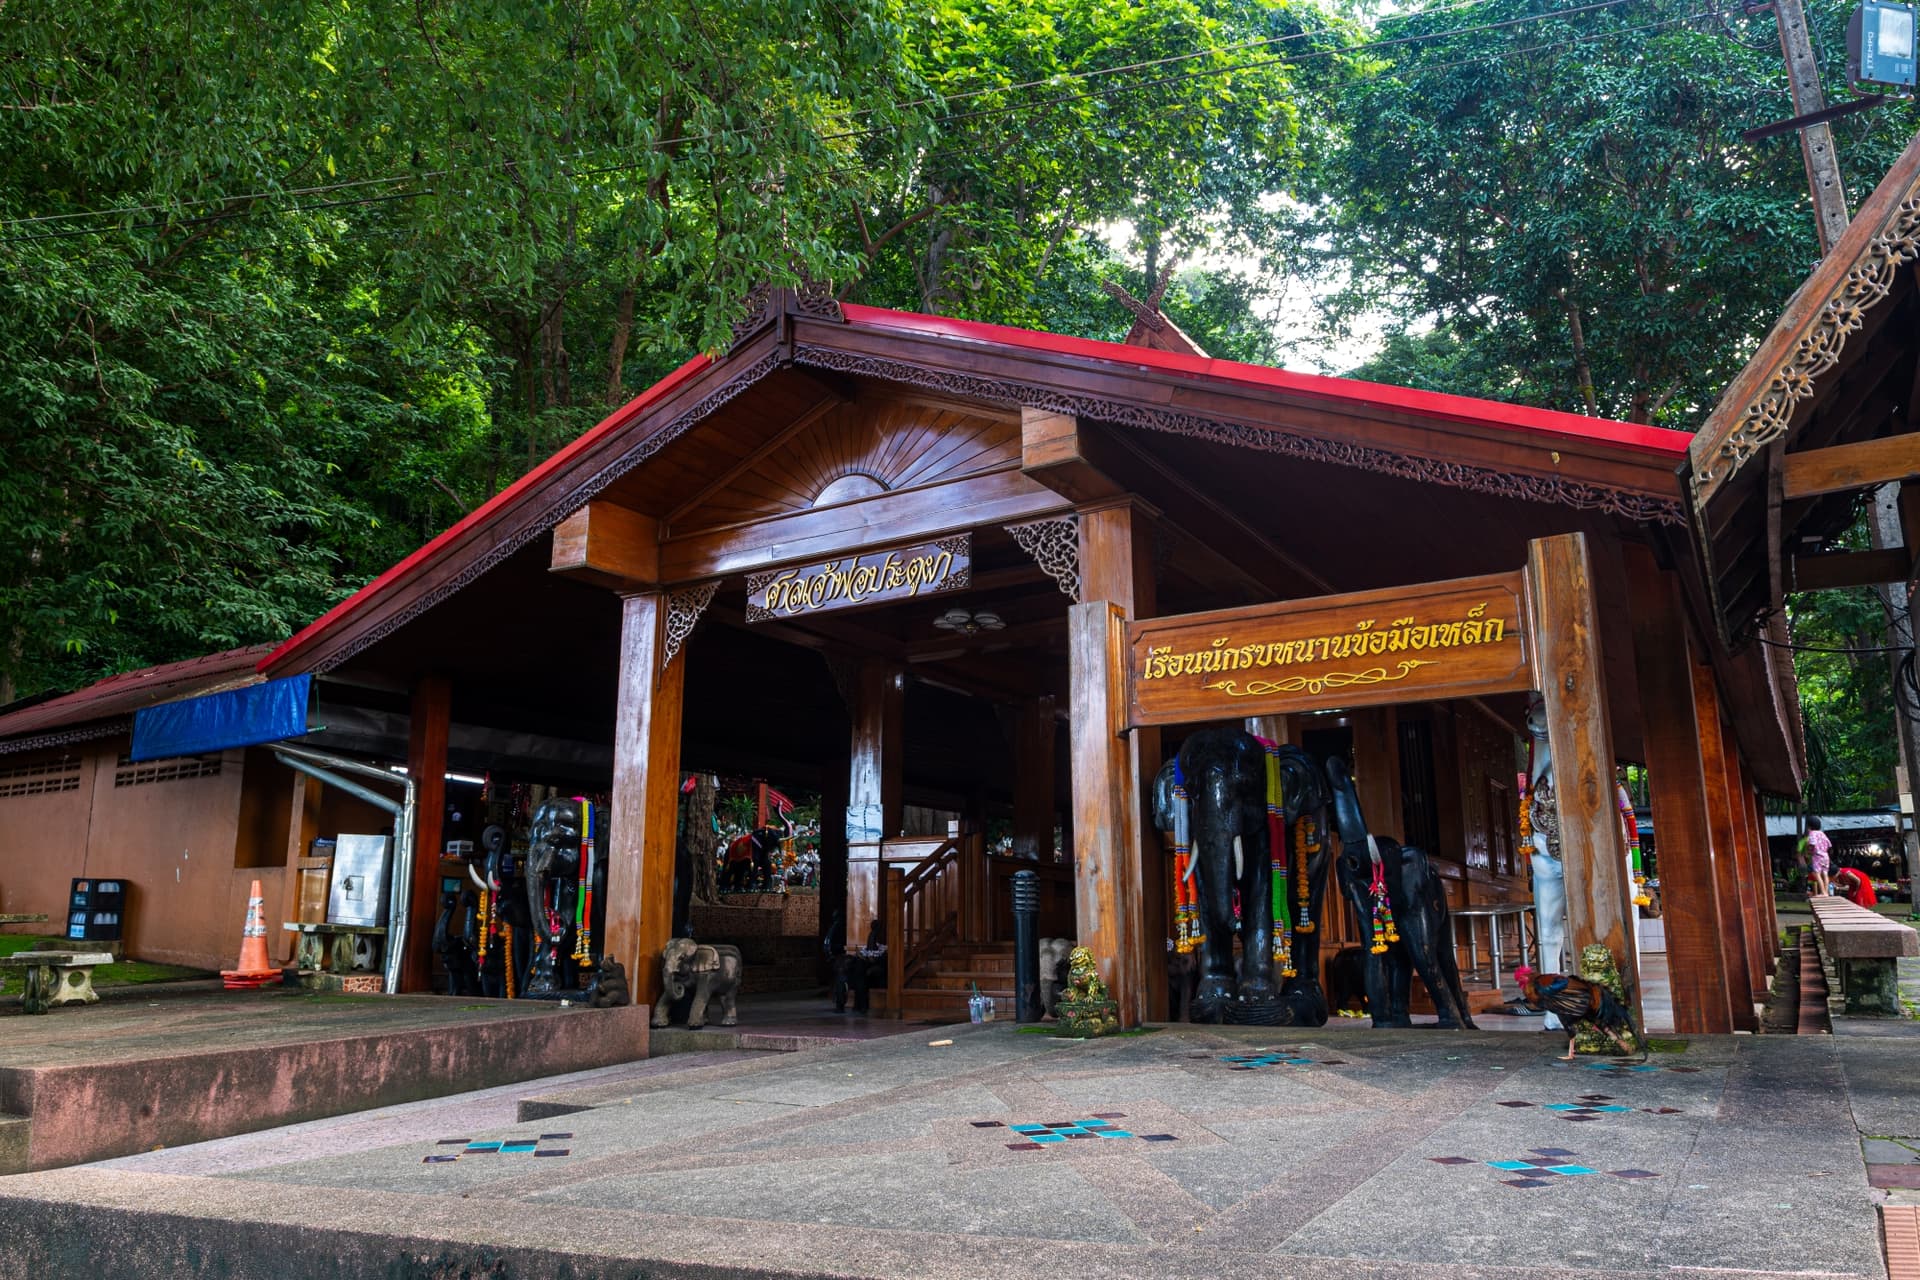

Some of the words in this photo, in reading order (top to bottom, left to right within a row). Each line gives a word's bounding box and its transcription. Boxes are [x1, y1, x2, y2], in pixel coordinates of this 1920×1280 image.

[765, 551, 953, 613] ศาลเจ้าพ่อประตูผา
[1144, 602, 1504, 679] เรือนนักรบหนานข้อมือเหล็ก
